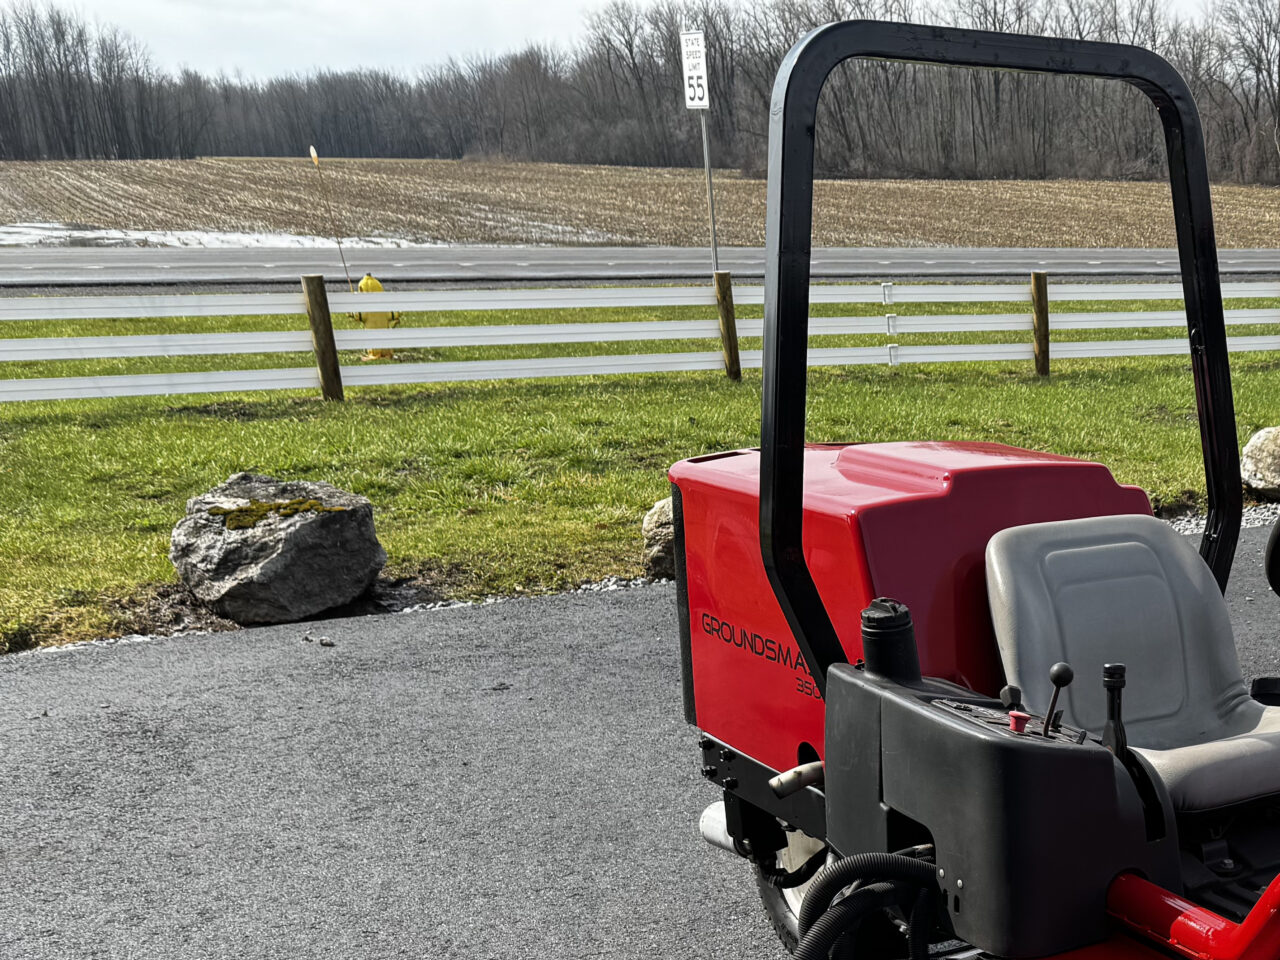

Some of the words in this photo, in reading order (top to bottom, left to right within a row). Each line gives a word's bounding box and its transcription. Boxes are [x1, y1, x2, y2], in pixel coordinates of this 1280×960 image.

[685, 37, 700, 47] STATE
[686, 50, 701, 60] SPEED
[688, 62, 701, 72] LIMIT
[688, 75, 705, 102] 55
[702, 612, 812, 677] GROUNDSMA
